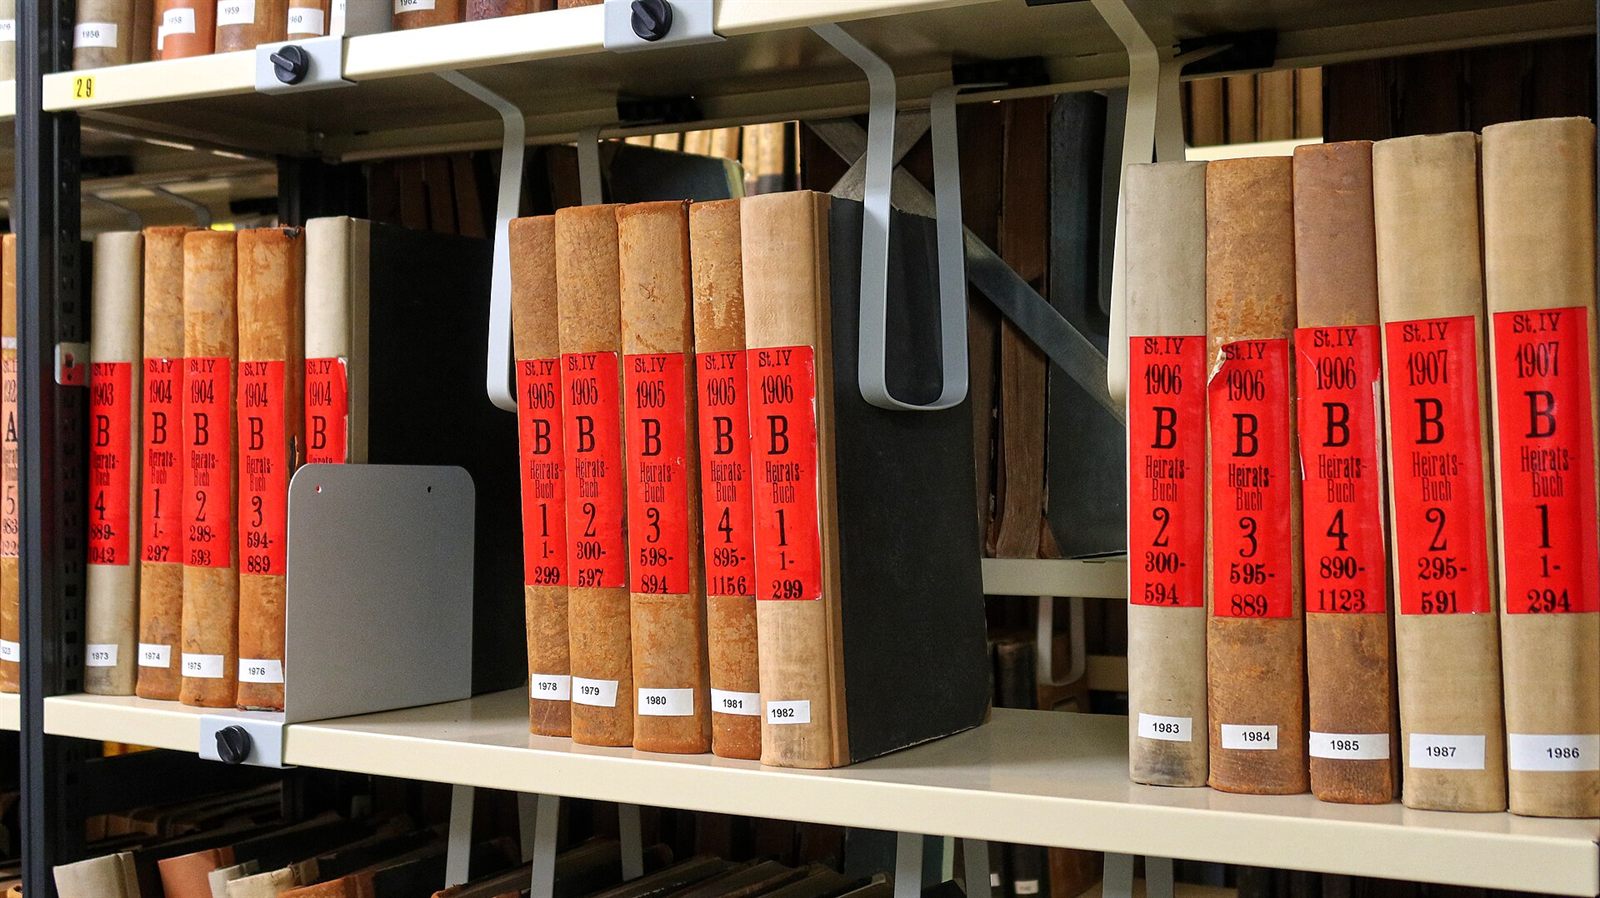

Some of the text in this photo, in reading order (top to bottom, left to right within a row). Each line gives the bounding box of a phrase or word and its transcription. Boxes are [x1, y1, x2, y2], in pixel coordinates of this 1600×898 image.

[76, 78, 92, 97] 29
[1402, 322, 1448, 343] St.IV
[1513, 312, 1562, 334] St.IV
[1144, 338, 1184, 356] St.IV
[1314, 328, 1358, 348] St.IV
[705, 354, 736, 370] St.IV
[758, 350, 792, 368] St.IV
[1225, 342, 1266, 360] St.IV
[1515, 341, 1560, 378] 1907
[149, 360, 174, 374] St.IV
[190, 360, 216, 374] St.IV
[244, 362, 268, 376] St.IV
[308, 361, 332, 375] St.IV
[525, 361, 554, 376] St.IV
[568, 354, 597, 372] St.IV
[635, 357, 666, 374] St.IV
[1316, 356, 1356, 390] 1906
[1407, 350, 1448, 386] 1907
[761, 375, 794, 404] 1906
[1144, 364, 1182, 394] 1906
[1226, 370, 1265, 402] 1906
[93, 382, 114, 406] 1903
[150, 380, 172, 404] 1904
[191, 380, 214, 404] 1904
[245, 382, 268, 408] 1904
[309, 381, 332, 406] 1904
[528, 382, 555, 410] 1905
[572, 378, 598, 406] 1905
[636, 380, 666, 408] 1905
[706, 377, 736, 406] 1905
[1322, 402, 1350, 447] B
[1414, 398, 1445, 445] B
[1524, 391, 1556, 438] B
[4, 411, 18, 442] A
[96, 414, 110, 446] B
[152, 412, 167, 444] B
[193, 412, 209, 446] B
[248, 417, 264, 450] B
[312, 416, 326, 450] B
[532, 418, 552, 454] B
[576, 416, 596, 453] B
[641, 418, 662, 456] B
[713, 416, 734, 455] B
[767, 416, 789, 455] B
[1151, 406, 1177, 449] B
[1232, 414, 1258, 456] B
[530, 460, 563, 480] Heirats-
[576, 458, 609, 478] Heirats-
[1146, 455, 1190, 479] Heirats-
[1318, 454, 1368, 479] Heirats-
[1412, 450, 1464, 478] Heirats-
[1520, 446, 1576, 472] Heirats-
[640, 462, 676, 483] Heirats-
[710, 460, 746, 482] Heirats-
[766, 460, 805, 483] Heirats-
[1228, 463, 1275, 488] Heirats-
[535, 479, 554, 499] Buch
[580, 478, 599, 498] Buch
[644, 482, 665, 503] Buch
[716, 481, 736, 502] Buch
[772, 482, 795, 504] Buch
[1152, 478, 1178, 502] Buch
[1327, 478, 1355, 503] Buch
[1422, 478, 1452, 502] Buch
[1532, 470, 1564, 498] Buch
[6, 486, 14, 514] 5
[95, 490, 106, 520] 4
[154, 488, 160, 518] 1
[195, 490, 206, 522] 2
[1236, 487, 1262, 511] Buch
[252, 496, 262, 528] 3
[539, 503, 550, 537] 1
[582, 502, 596, 537] 2
[153, 522, 164, 538] 1-
[190, 525, 216, 542] 298-
[646, 507, 660, 544] 3
[718, 507, 734, 544] 4
[776, 508, 788, 546] 1
[1152, 507, 1170, 547] 2
[1239, 516, 1258, 558] 3
[1326, 508, 1349, 551] 4
[1425, 508, 1448, 552] 2
[1536, 504, 1552, 548] 1
[247, 532, 274, 548] 594-
[542, 541, 554, 559] 1-
[576, 541, 606, 560] 300-
[147, 545, 170, 562] 297
[191, 549, 212, 566] 593
[247, 556, 270, 572] 889
[640, 548, 674, 567] 598-
[713, 548, 746, 568] 895-
[779, 551, 794, 570] 1-
[1145, 552, 1186, 574] 300-
[534, 566, 560, 585] 299
[1230, 563, 1275, 585] 595-
[1320, 556, 1366, 579] 890-
[1418, 557, 1468, 580] 295-
[1540, 554, 1561, 578] 1-
[578, 568, 604, 588] 597
[641, 575, 668, 594] 894
[713, 576, 747, 596] 1156
[772, 579, 802, 599] 299
[1144, 583, 1180, 604] 594
[1231, 594, 1268, 616] 889
[1318, 589, 1366, 612] 1123
[1421, 590, 1458, 614] 591
[1527, 588, 1572, 614] 294
[92, 652, 109, 660] 1973
[144, 652, 161, 660] 1974
[187, 662, 202, 670] 1975
[248, 667, 266, 676] 1976
[538, 682, 558, 691] 1978
[580, 686, 600, 696] 1979
[646, 695, 667, 706] 1980
[722, 698, 743, 709] 1981
[771, 708, 794, 718] 1982
[1152, 722, 1180, 734] 1983
[1241, 731, 1271, 742] 1984
[1329, 740, 1360, 751] 1985
[1425, 746, 1457, 758] 1987
[1546, 748, 1580, 760] 1986
